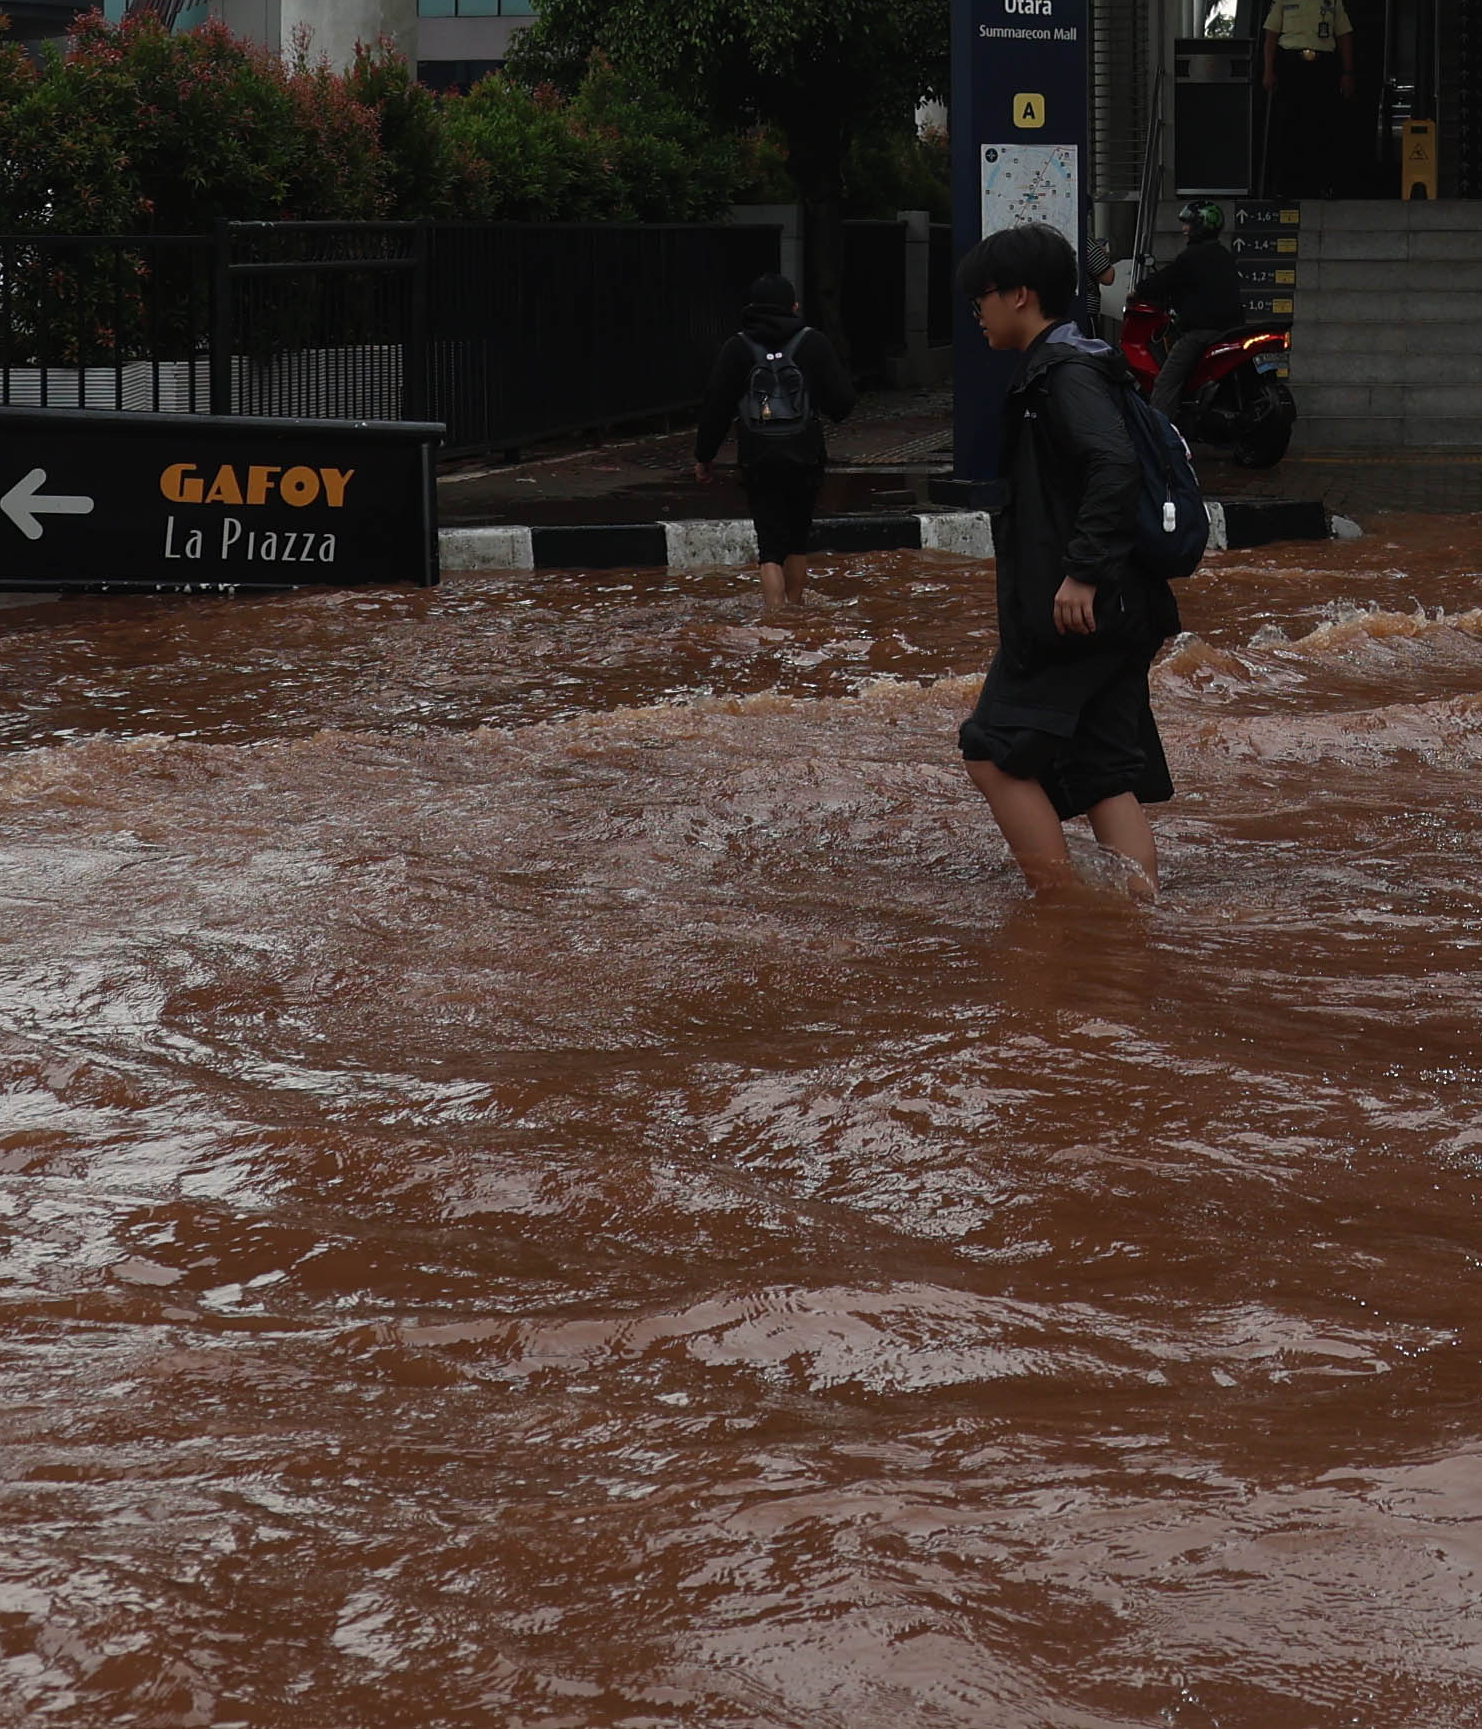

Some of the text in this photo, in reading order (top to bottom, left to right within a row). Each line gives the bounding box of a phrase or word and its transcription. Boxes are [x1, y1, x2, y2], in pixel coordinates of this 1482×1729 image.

[979, 24, 1077, 42] Summarecon Mall
[1022, 102, 1036, 120] A
[159, 463, 355, 508] GAFOY
[165, 516, 337, 563] La Piazza
